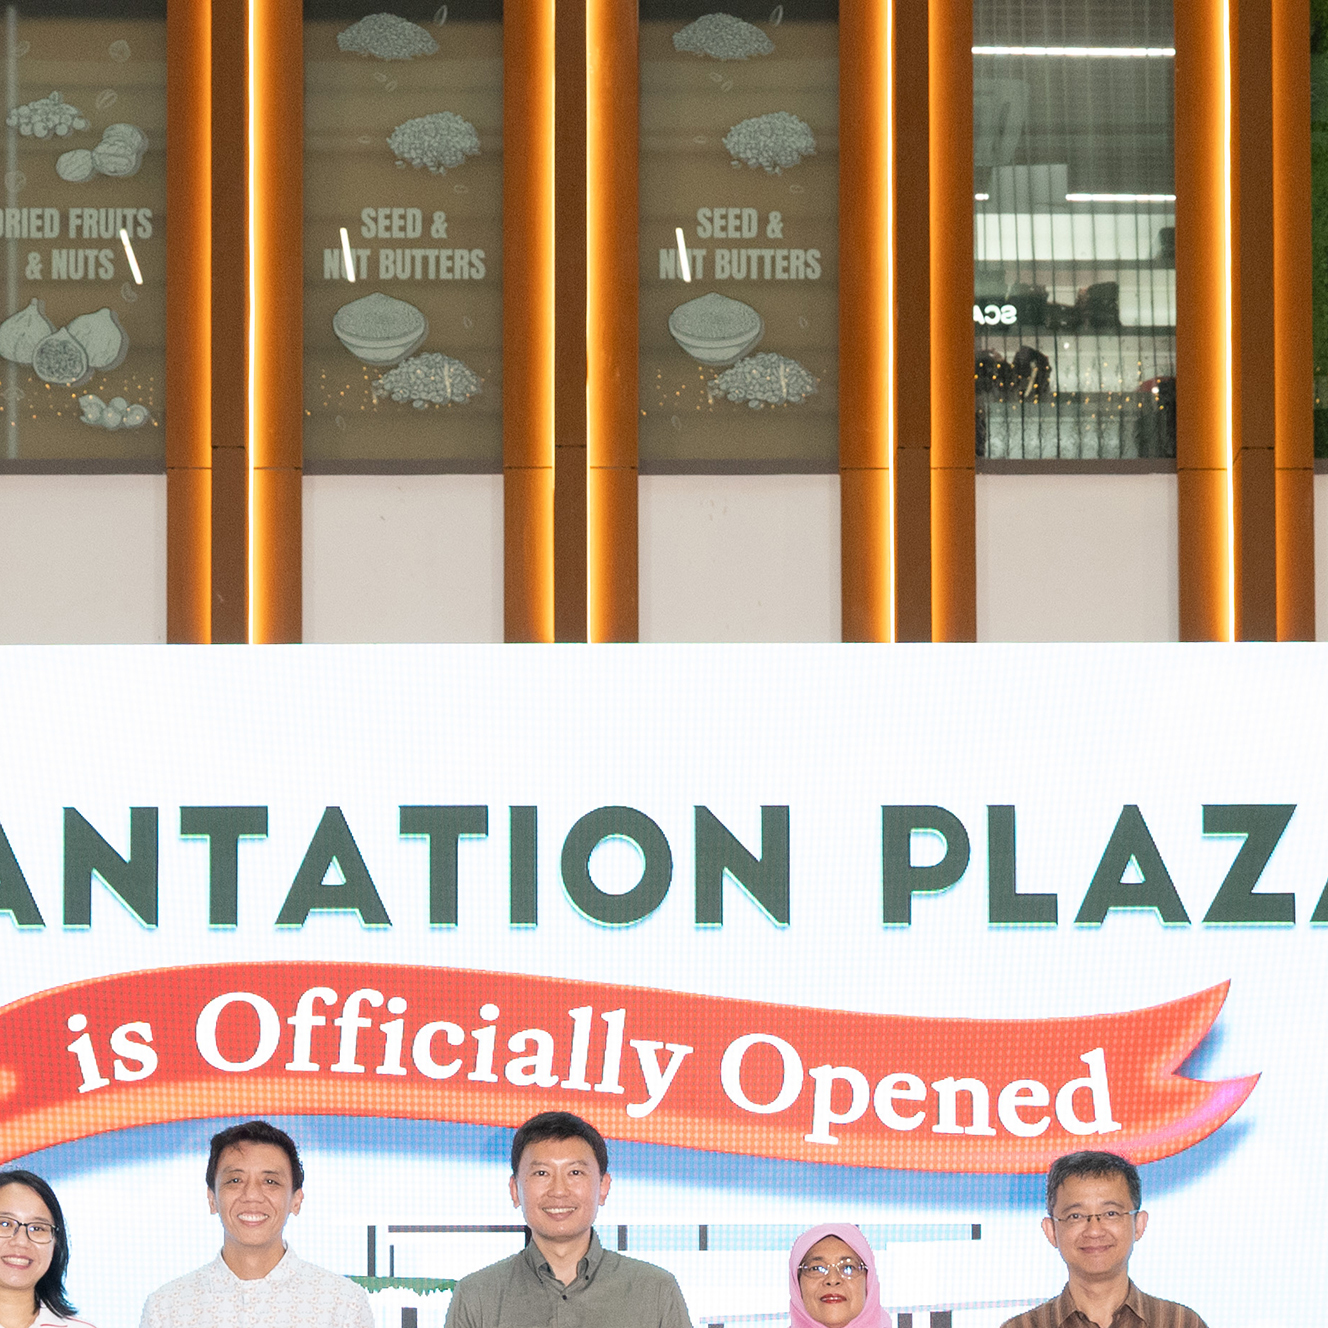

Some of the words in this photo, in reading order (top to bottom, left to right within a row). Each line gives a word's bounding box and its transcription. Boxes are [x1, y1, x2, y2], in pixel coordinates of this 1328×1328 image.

[69, 207, 153, 239] FRUITS
[360, 207, 423, 239] SEED
[430, 208, 448, 239] &
[696, 207, 759, 239] SEED
[765, 208, 784, 239] &
[26, 249, 43, 280] &
[51, 248, 115, 280] NUTS
[323, 249, 371, 280] NUT
[379, 249, 486, 280] BUTTERS
[659, 249, 707, 280] NUT
[714, 249, 821, 280] BUTTERS
[67, 1013, 159, 1094] is
[195, 986, 694, 1119] Officially
[719, 1033, 1123, 1147] Opened
